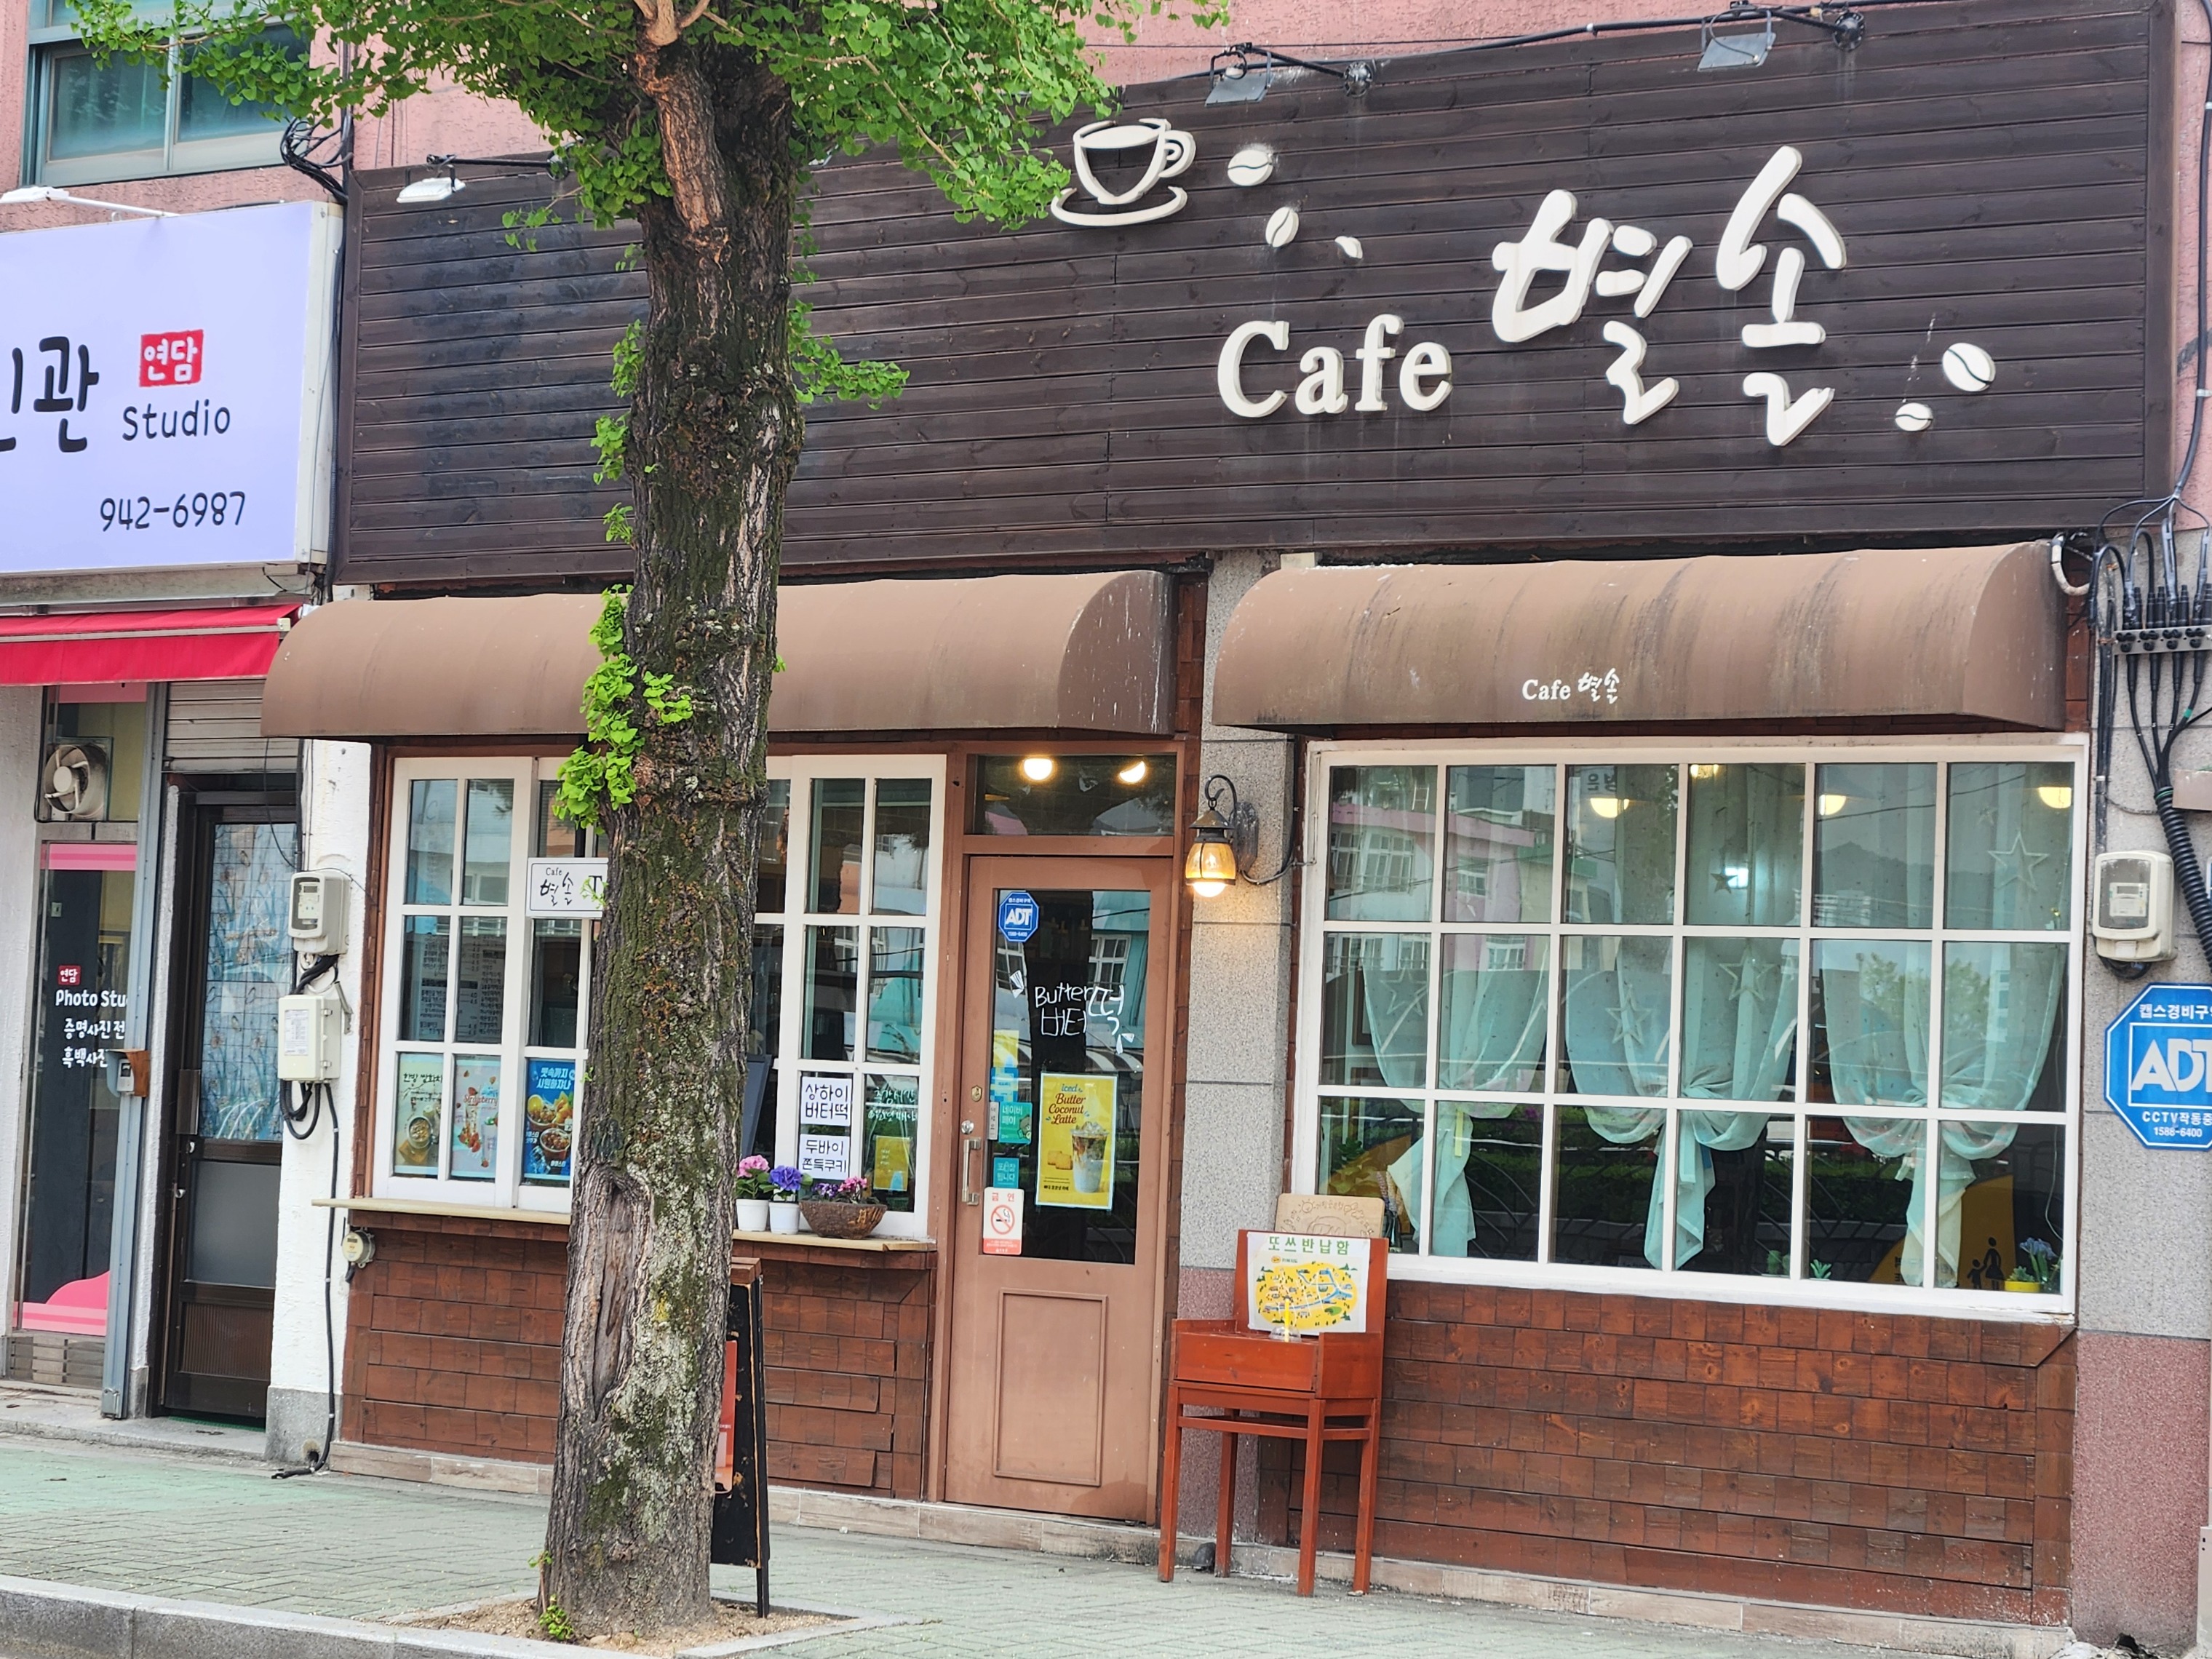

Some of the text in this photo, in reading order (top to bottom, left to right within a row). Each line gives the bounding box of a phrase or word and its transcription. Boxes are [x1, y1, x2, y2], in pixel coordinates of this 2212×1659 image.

[1492, 146, 1847, 447] 별솔
[143, 337, 199, 383] 연담
[1217, 314, 1453, 418] Cafe
[122, 399, 231, 441] Studio
[100, 490, 246, 532] 942-6987
[1521, 667, 1620, 704] Cafe 별솔
[546, 867, 562, 876] Cafe
[1005, 907, 1033, 926] ADT
[60, 968, 79, 983] 연담
[55, 989, 127, 1007] Photo Stu
[1034, 982, 1093, 1008] Butter
[63, 1018, 111, 1040] 증명사진
[805, 1083, 848, 1102] 상하이
[1061, 1084, 1078, 1093] iced
[1055, 1093, 1086, 1105] Butter
[805, 1102, 848, 1121] 버터떡
[1049, 1105, 1084, 1115] Coconut
[1051, 1114, 1077, 1125] Latte
[2154, 1126, 2203, 1138] 1588-6400
[805, 1139, 844, 1155] 두바이
[803, 1158, 846, 1173] 쫀득쿠키
